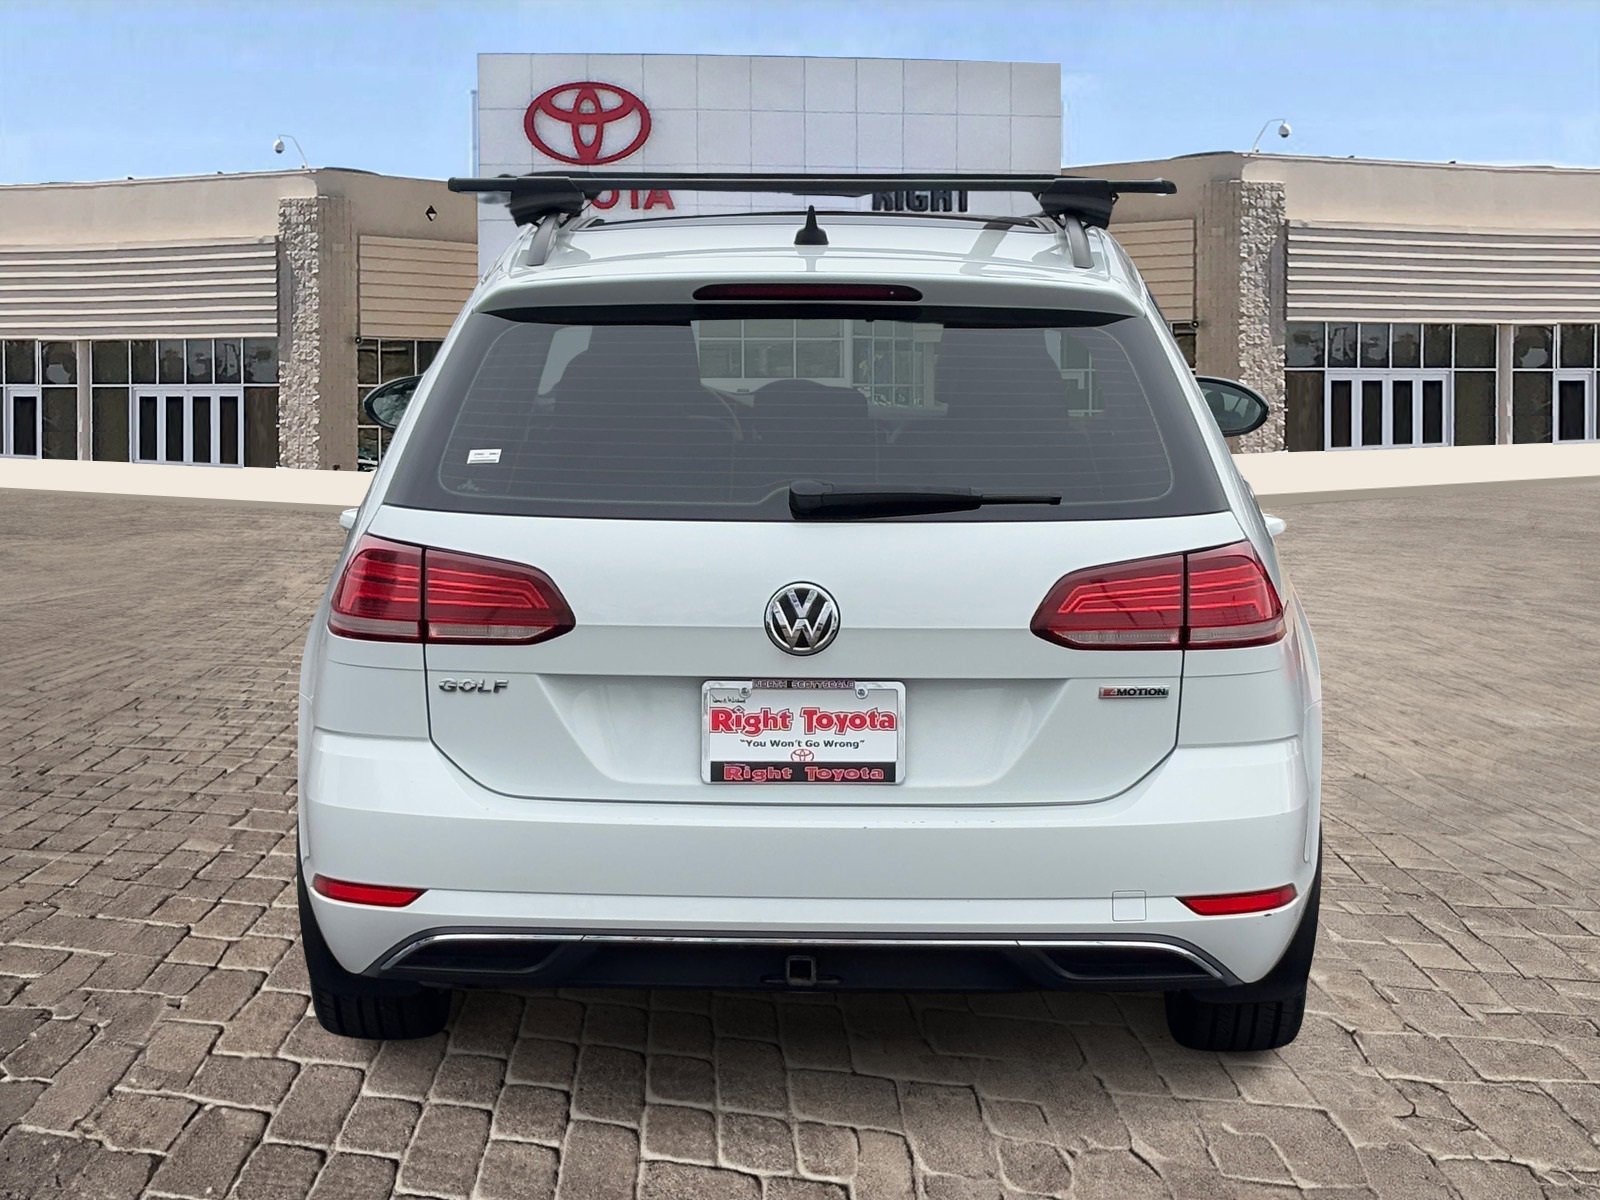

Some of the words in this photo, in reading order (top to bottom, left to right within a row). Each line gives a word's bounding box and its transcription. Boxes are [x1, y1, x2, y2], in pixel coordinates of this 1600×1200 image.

[439, 678, 509, 693] GOLF
[710, 706, 794, 737] Right
[800, 706, 897, 736] Toyota
[805, 739, 820, 748] Go
[723, 765, 793, 782] Right
[805, 766, 884, 781] Toyota
